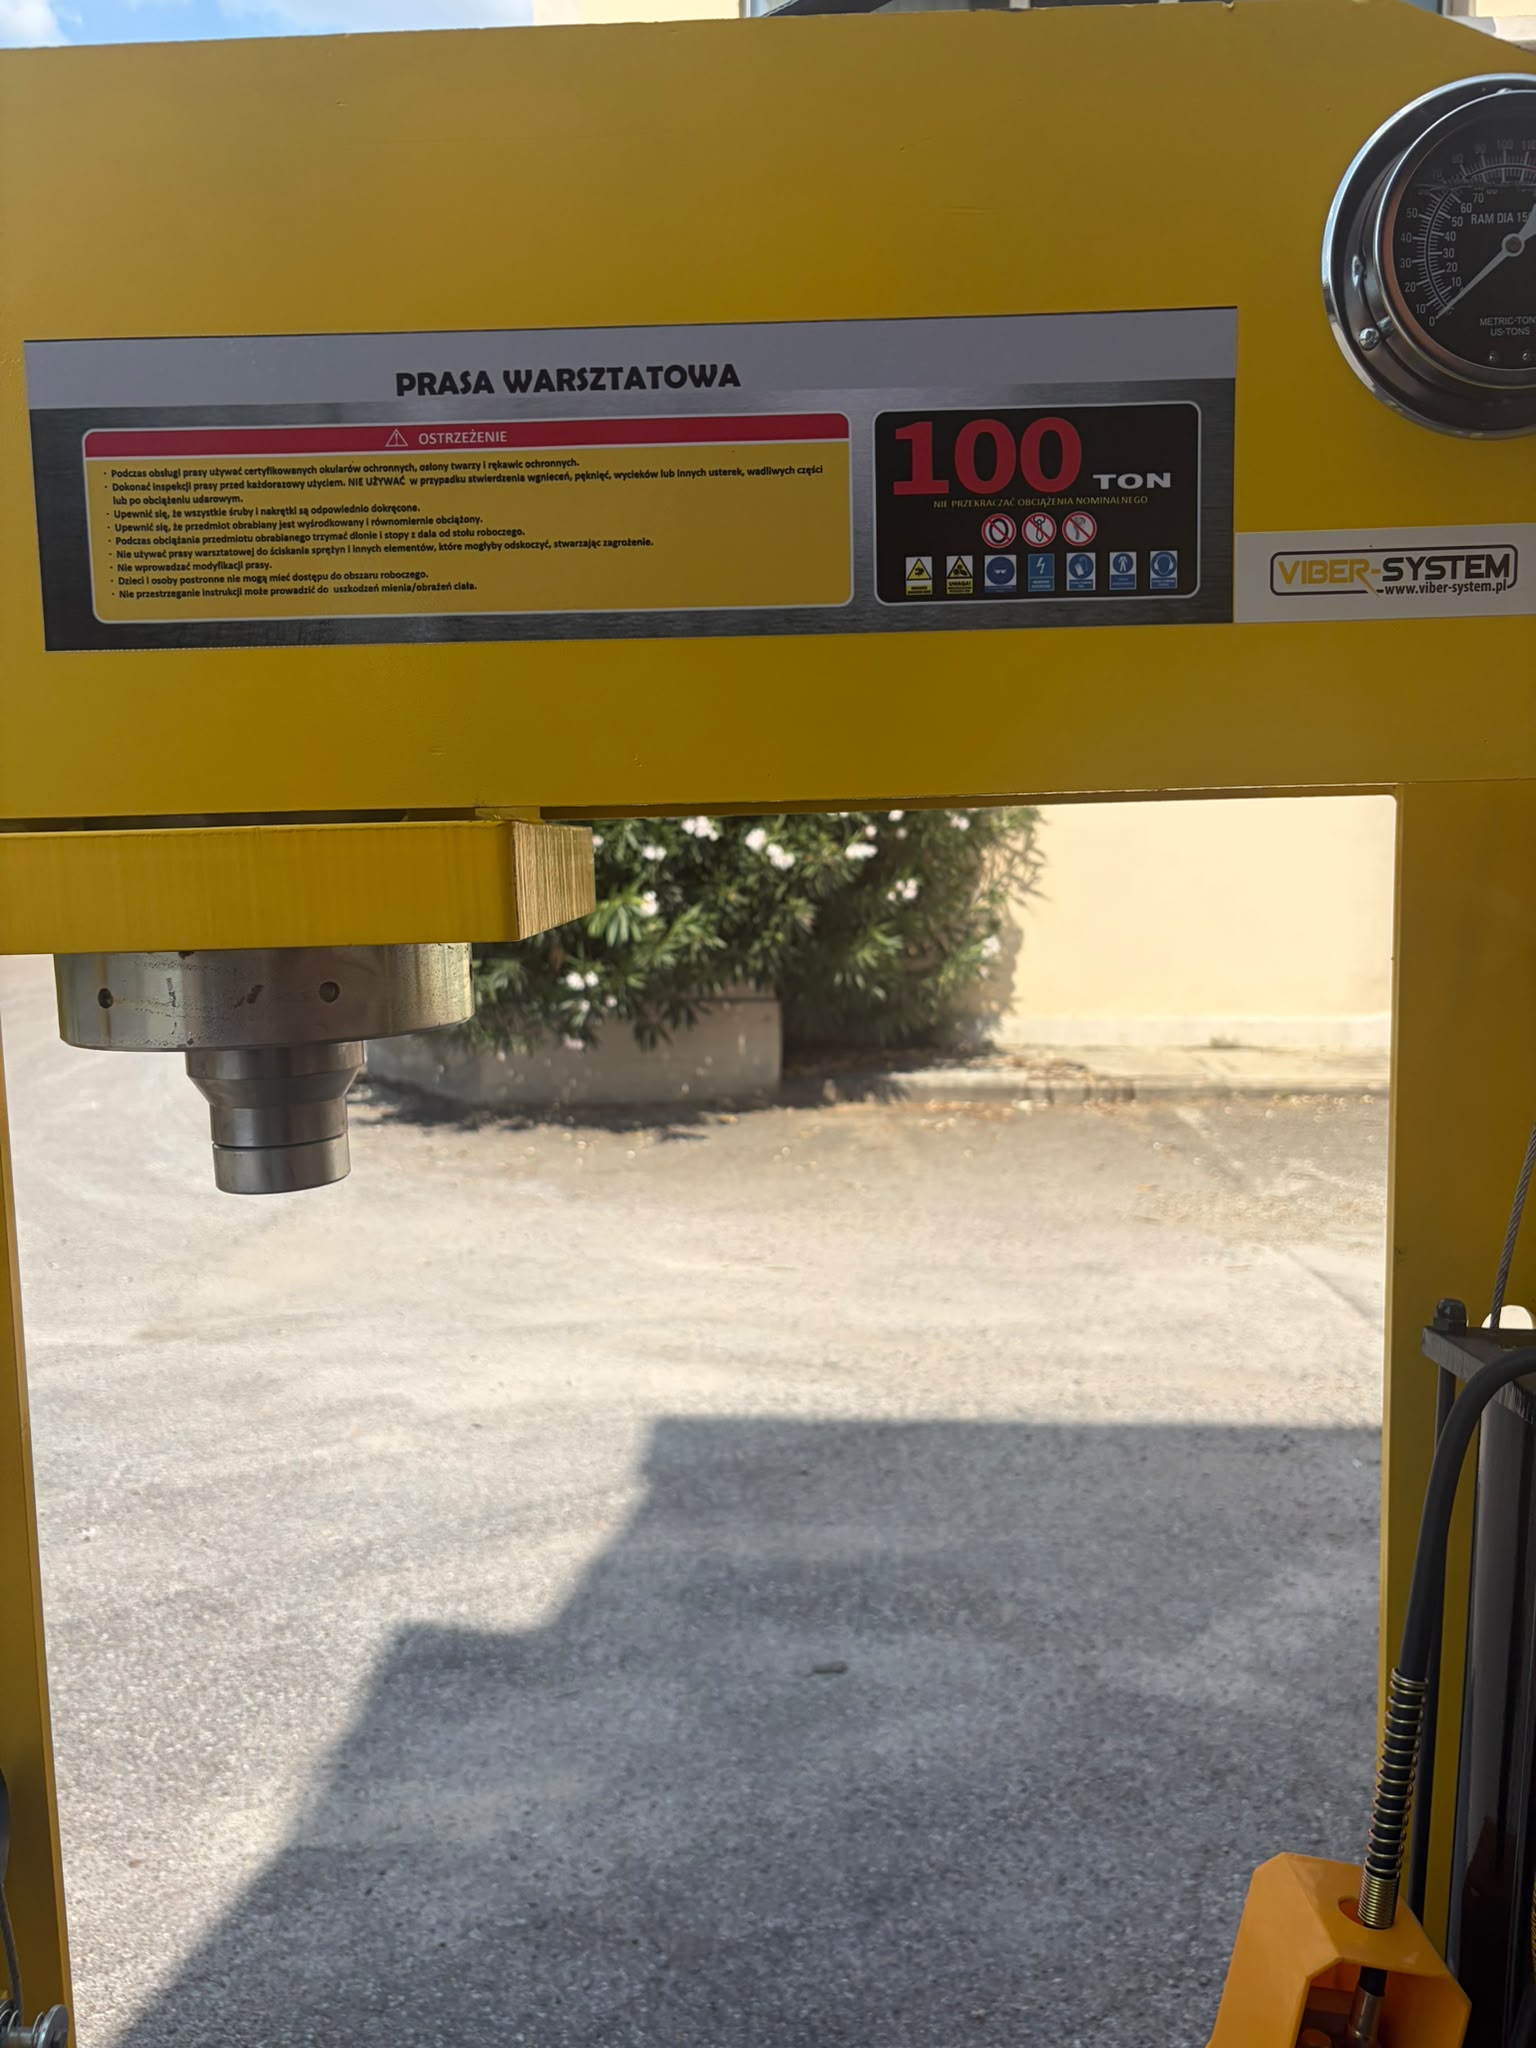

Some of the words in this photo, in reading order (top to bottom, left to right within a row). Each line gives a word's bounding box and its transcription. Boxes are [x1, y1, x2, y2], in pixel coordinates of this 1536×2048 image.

[1473, 192, 1484, 203] 70
[1406, 208, 1418, 217] 50
[1460, 203, 1472, 213] 60
[1451, 217, 1463, 227] 50
[1470, 213, 1494, 224] RAM
[1497, 212, 1514, 224] DIA
[1516, 211, 1528, 223] 15
[1444, 232, 1456, 241] 40
[1442, 248, 1455, 258] 30
[1400, 258, 1411, 268] 30
[1446, 263, 1457, 272] 20
[1404, 282, 1416, 292] 20
[1451, 277, 1462, 287] 10
[1416, 304, 1426, 314] 10
[1429, 317, 1435, 327] 0
[1479, 316, 1536, 327] METRIC-TON
[1490, 327, 1530, 336] US-TONS
[396, 369, 494, 396] PRASA
[503, 363, 741, 394] WARSZTATOWA
[418, 430, 507, 445] OSTRZEŻENIE
[893, 417, 1082, 496] 100
[1093, 472, 1171, 490] TON
[110, 468, 147, 478] Podczas
[148, 467, 181, 480] obsługi
[182, 469, 207, 479] prasy
[209, 465, 242, 479] używać
[243, 464, 317, 478] certyfikowanych
[319, 463, 361, 473] okularów
[362, 462, 417, 475] ochronnych,
[419, 461, 448, 474] osłony
[450, 461, 481, 473] twarzy
[487, 459, 523, 472] rękawic
[524, 458, 579, 471] ochronnych.
[112, 481, 151, 491] Dokonać
[152, 480, 191, 493] inspekcji
[193, 482, 218, 492] prasy
[219, 479, 245, 492] przed
[246, 477, 305, 491] każdorazowy
[306, 477, 345, 490] użyciem.
[348, 476, 363, 486] NIE
[365, 473, 405, 486] UŻYWAĆ
[419, 474, 466, 487] przypadku
[468, 472, 525, 483] stwierdzenia
[527, 471, 572, 485] wgnieceń,
[574, 471, 611, 484] pęknięć,
[613, 469, 658, 483] wycieków
[660, 469, 675, 479] lub
[676, 468, 706, 481] innych
[708, 468, 744, 481] usterek,
[746, 466, 795, 480] wadliwych
[796, 466, 823, 479] części
[112, 495, 127, 505] lub
[129, 497, 141, 507] po
[142, 493, 190, 507] obciążeniu
[192, 492, 243, 506] udarowym.
[933, 500, 948, 508] NIE
[1018, 496, 1074, 508] OBCIĄŻENIA
[1075, 495, 1149, 505] NOMINALNEGO
[113, 508, 153, 521] Upewnić
[154, 507, 170, 520] się,
[172, 507, 182, 517] że
[183, 506, 227, 519] wszystkie
[228, 505, 253, 518] śruby
[260, 504, 297, 517] nakrętki
[298, 507, 309, 517] są
[310, 503, 369, 516] odpowiednio
[370, 502, 420, 515] dokręcone.
[114, 521, 154, 534] Upewnić
[155, 521, 171, 533] się,
[172, 520, 183, 530] że
[184, 519, 230, 533] przedmiot
[231, 518, 277, 531] obrabiany
[278, 518, 295, 530] jest
[296, 516, 364, 530] wyśrodkowany
[370, 515, 433, 526] równomiernie
[435, 514, 482, 527] obciążony.
[115, 534, 151, 545] Podczas
[152, 533, 200, 547] obciążania
[202, 532, 253, 545] przedmiotu
[254, 531, 311, 544] obrabianego
[312, 530, 348, 543] trzymać
[349, 529, 377, 539] dłonie
[384, 530, 409, 541] stopy
[417, 528, 437, 538] dala
[438, 528, 450, 537] od
[452, 527, 475, 537] stołu
[476, 526, 525, 539] roboczego.
[116, 548, 132, 558] Nie
[133, 547, 167, 560] używać
[168, 550, 193, 560] prasy
[194, 545, 254, 559] warsztatowej
[256, 545, 268, 555] do
[269, 544, 309, 555] ściskania
[311, 543, 345, 556] sprężyn
[352, 543, 381, 555] innych
[383, 541, 436, 555] elementów,
[438, 541, 462, 551] które
[464, 540, 502, 553] mogłyby
[503, 539, 551, 552] odskoczyć,
[553, 538, 601, 551] stwarzając
[602, 536, 653, 550] zagrożenie.
[117, 561, 133, 571] Nie
[134, 560, 191, 574] wprowadzać
[192, 559, 243, 572] modyfikacji
[244, 561, 272, 571] prasy.
[1277, 554, 1511, 590] VIBER-SYSTEM
[118, 575, 144, 585] Dzieci
[150, 574, 178, 587] osoby
[179, 574, 225, 586] postronne
[226, 572, 241, 582] nie
[242, 575, 268, 585] mogą
[269, 571, 290, 581] mieć
[291, 570, 328, 584] dostępu
[329, 570, 342, 580] do
[343, 569, 378, 580] obszaru
[380, 568, 428, 582] roboczego.
[119, 588, 134, 598] Nie
[136, 587, 200, 600] przestrzeganie
[202, 586, 242, 599] instrukcji
[244, 585, 268, 595] może
[270, 584, 315, 597] prowadzić
[316, 584, 329, 594] do
[333, 583, 379, 593] uszkodzeń
[381, 581, 452, 595] mienia/obrażeń
[453, 580, 477, 591] ciała.
[1384, 579, 1508, 596] www.viber-system.pl
